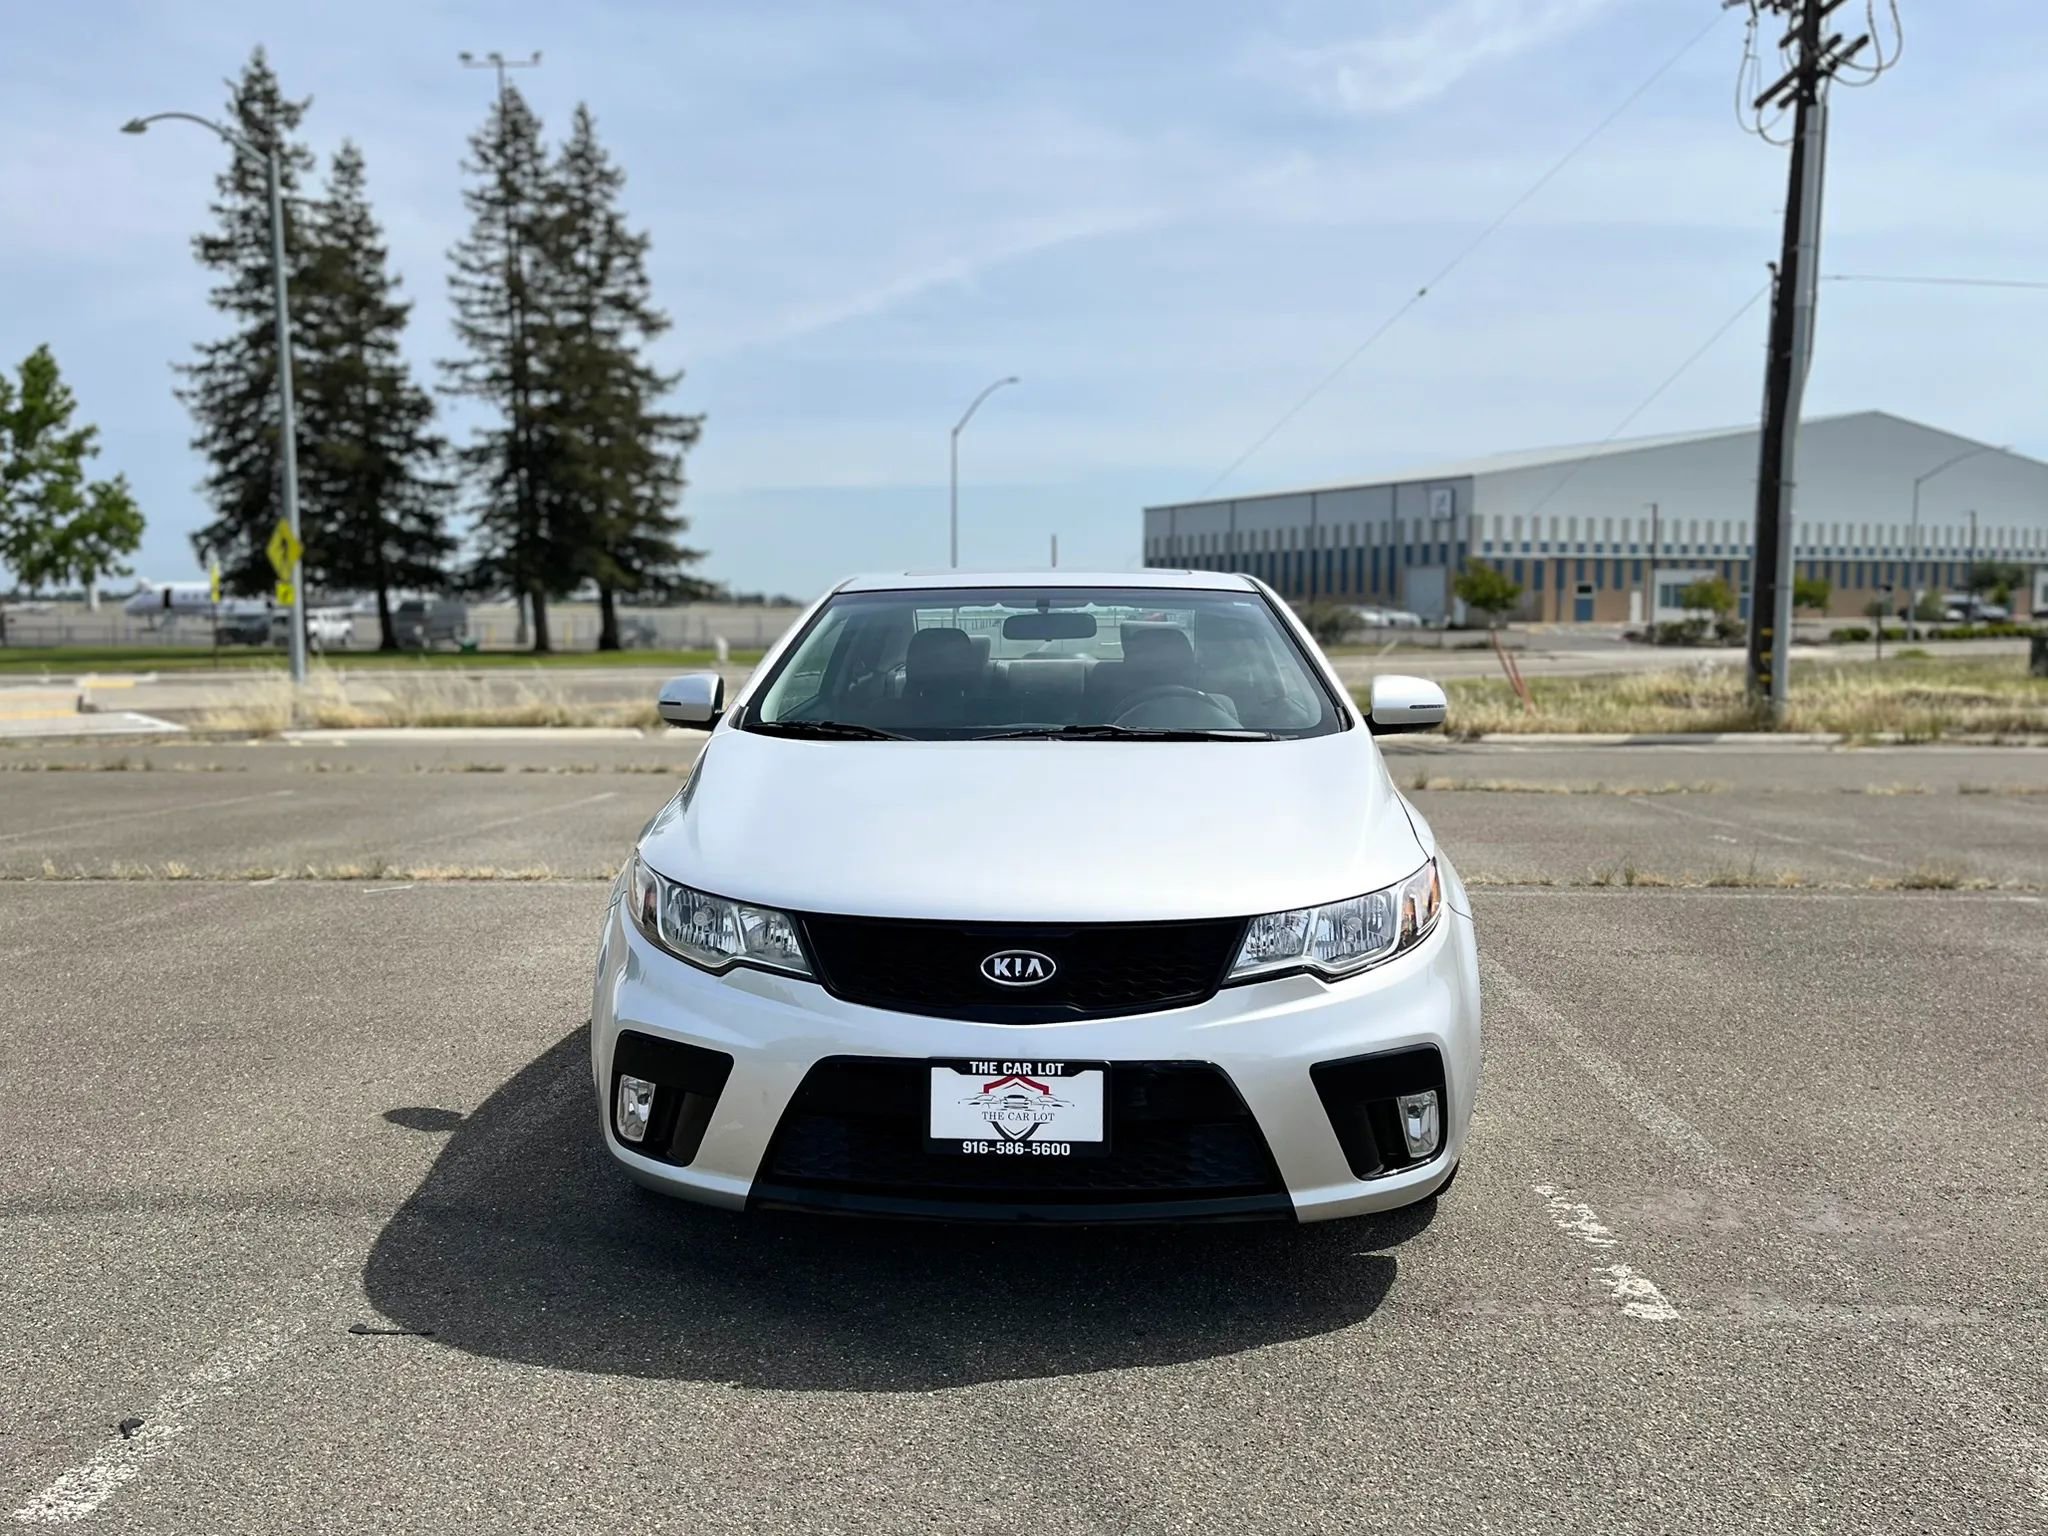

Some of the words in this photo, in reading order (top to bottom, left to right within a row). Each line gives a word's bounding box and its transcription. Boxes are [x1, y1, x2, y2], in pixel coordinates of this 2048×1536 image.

[994, 957, 1044, 977] KIA
[970, 1061, 998, 1075] THE
[1002, 1062, 1032, 1075] CAR
[1037, 1063, 1065, 1076] LOT
[982, 1111, 1005, 1121] THE
[1007, 1112, 1030, 1121] CAR
[1033, 1112, 1055, 1121] LOT
[962, 1141, 1071, 1156] 916-586-5600
